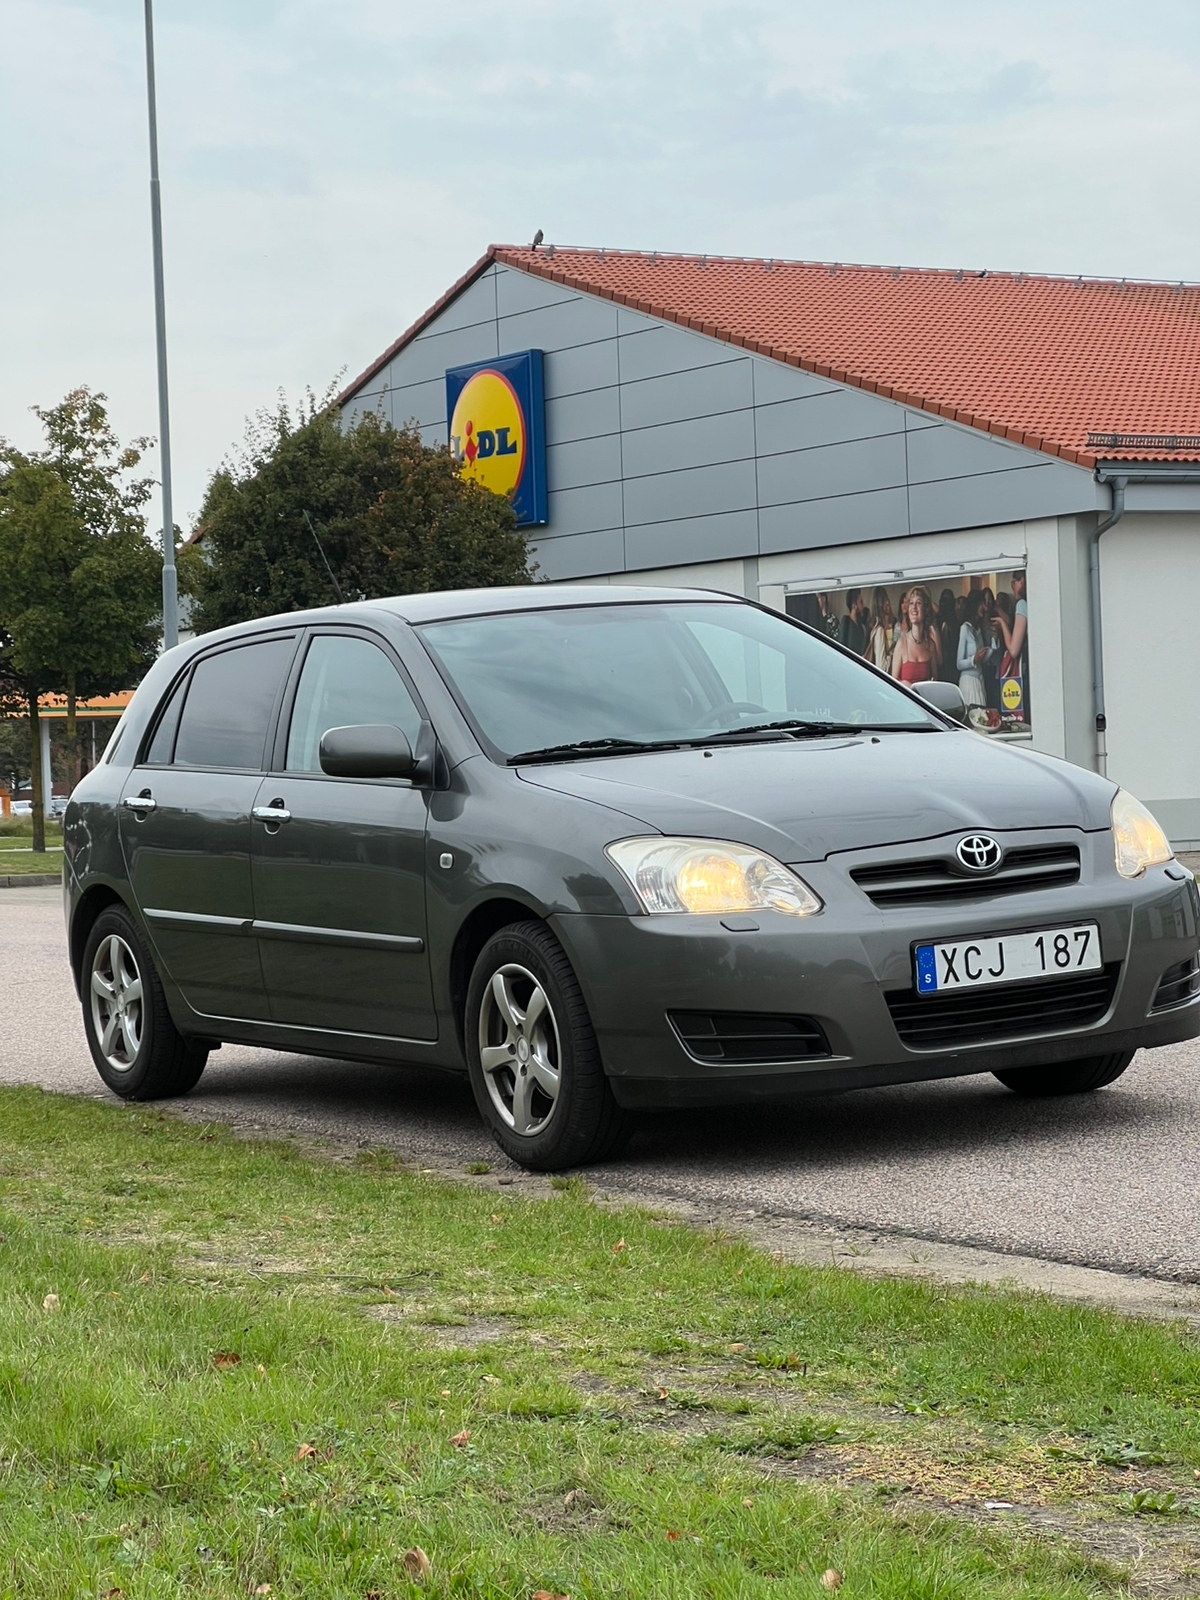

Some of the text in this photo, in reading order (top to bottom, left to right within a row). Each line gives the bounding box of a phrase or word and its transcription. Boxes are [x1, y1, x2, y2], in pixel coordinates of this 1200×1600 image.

[940, 930, 1091, 984] XCJ 187
[924, 973, 932, 984] S
